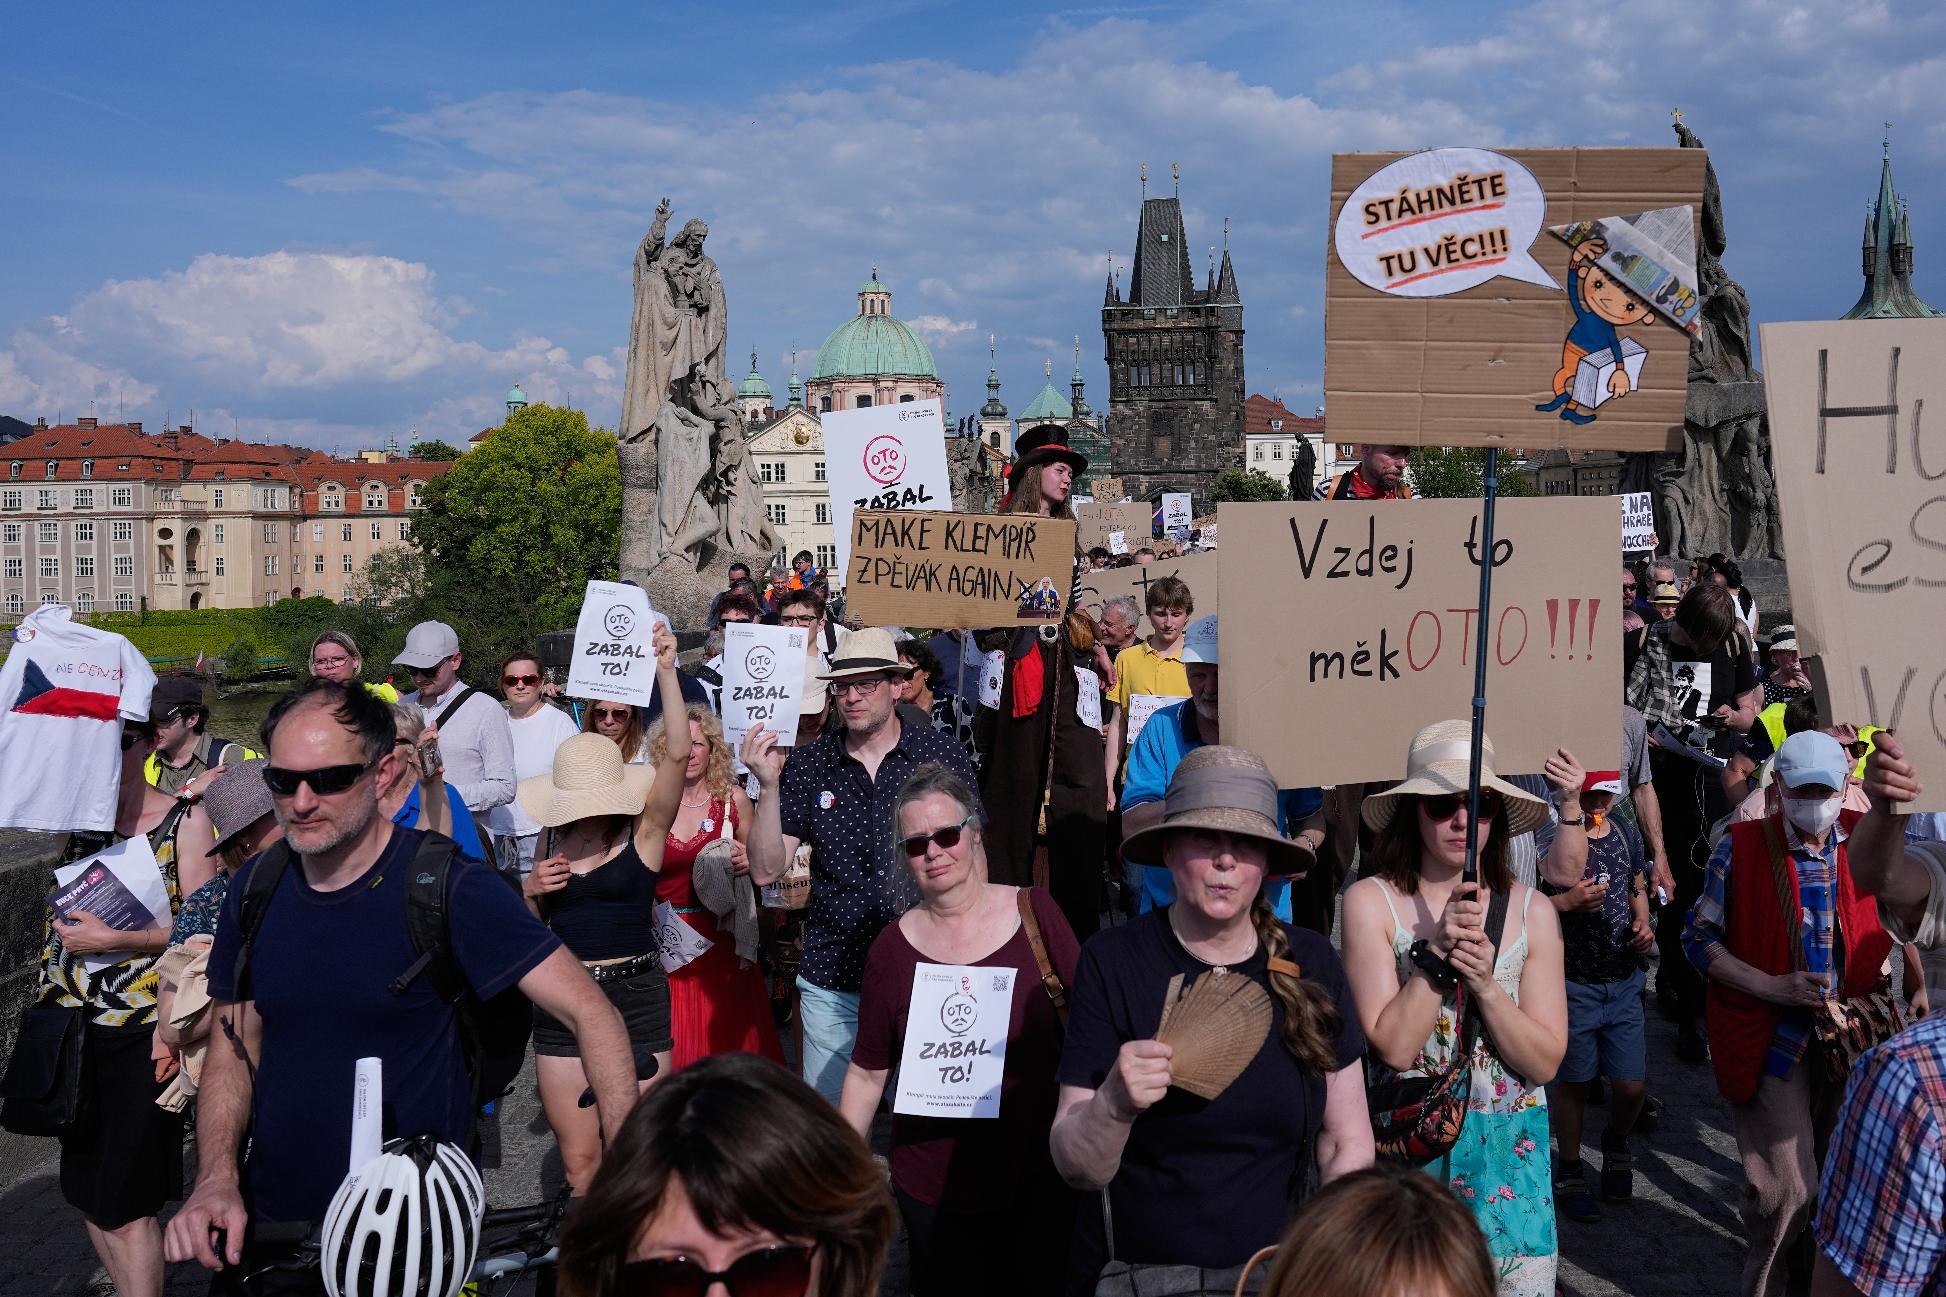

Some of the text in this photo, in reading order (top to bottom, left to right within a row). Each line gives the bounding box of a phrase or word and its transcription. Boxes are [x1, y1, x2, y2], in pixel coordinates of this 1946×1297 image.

[1364, 174, 1506, 225] STÁHNĚTE
[1379, 229, 1509, 277] TU VĚC!!!
[871, 448, 899, 466] OTO
[1629, 494, 1652, 514] NA
[857, 517, 1037, 562] MAKE KLEMPÍŘ
[1289, 515, 1513, 590] Vzdej to
[855, 553, 1012, 600] ZPĚVÁK AGAIN
[610, 614, 630, 624] OTO
[585, 641, 646, 658] ZABAL
[56, 663, 73, 674] NE
[600, 661, 630, 676] TO!
[750, 655, 771, 666] OTO
[732, 685, 790, 701] ZABAL
[746, 703, 775, 720] TO!
[947, 1003, 972, 1016] OTO
[919, 1038, 992, 1060] ZABAL
[939, 1060, 973, 1085] TO!
